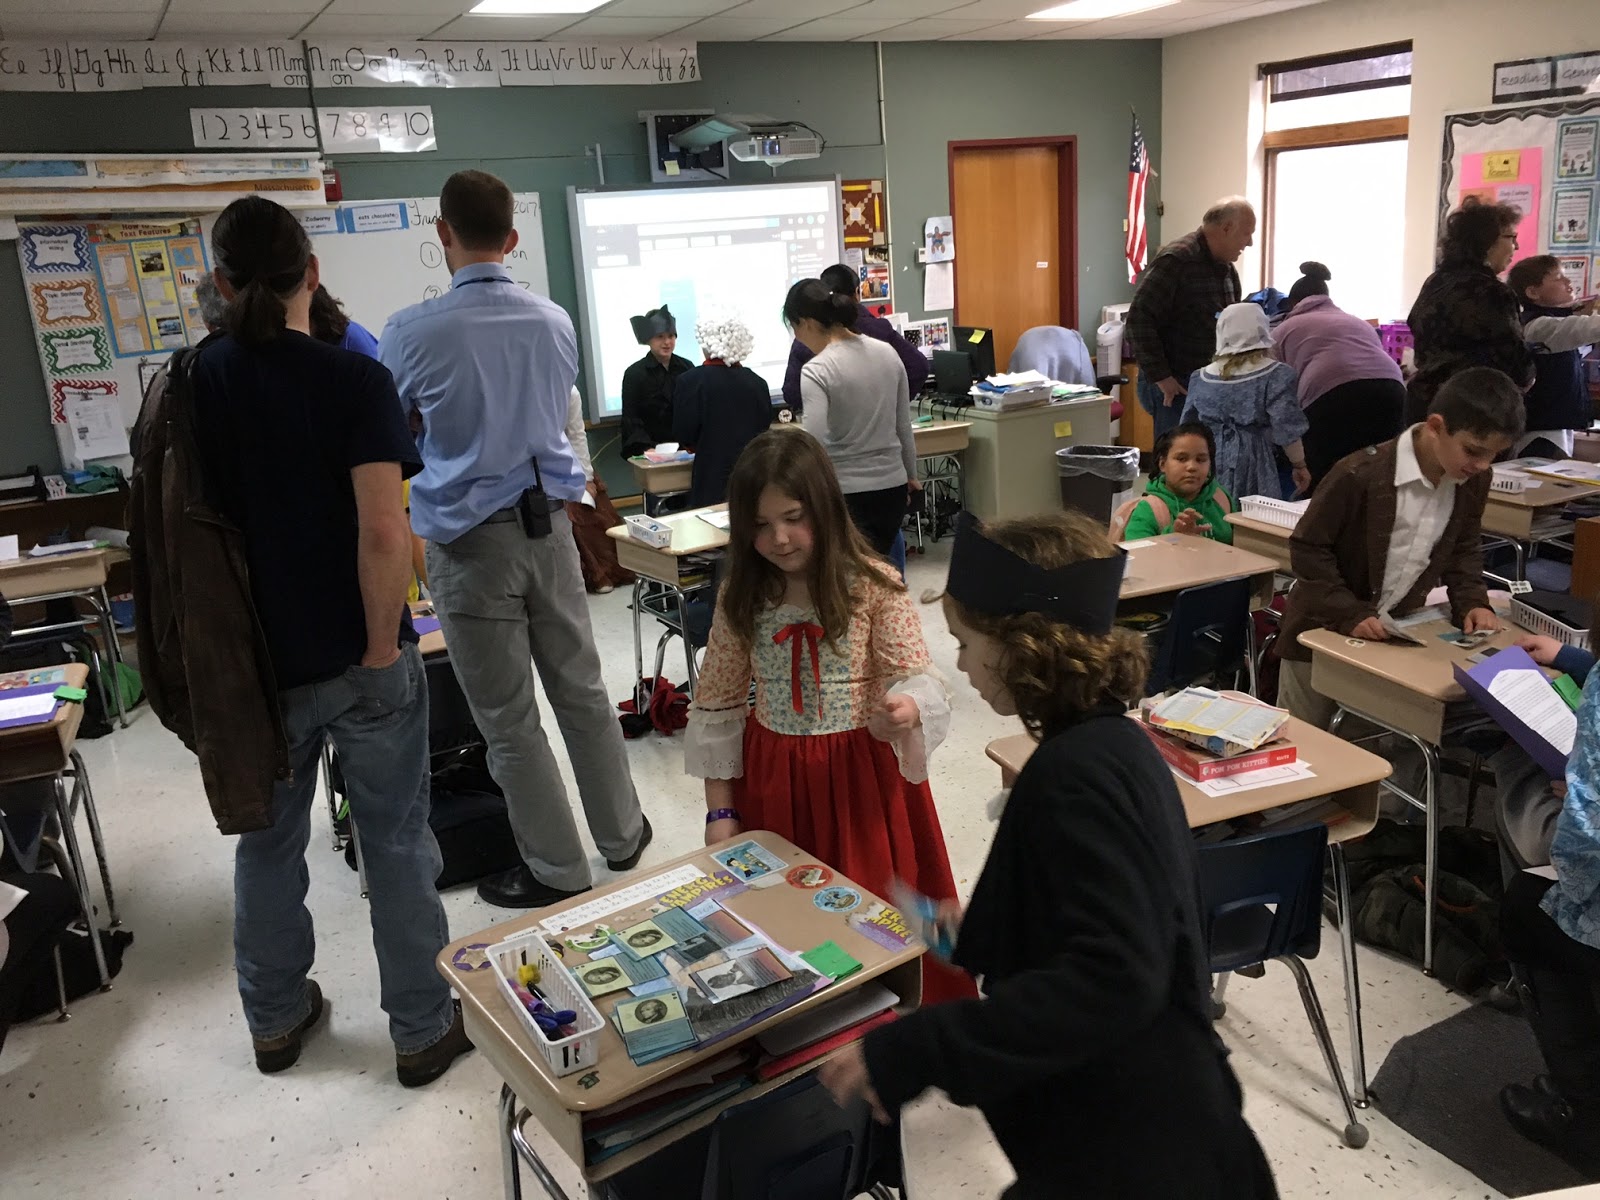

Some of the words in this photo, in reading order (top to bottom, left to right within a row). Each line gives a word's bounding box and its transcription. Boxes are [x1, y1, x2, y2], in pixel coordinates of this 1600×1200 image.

[1500, 73, 1550, 86] Reading
[200, 114, 207, 140] 1
[215, 115, 231, 140] 2
[239, 114, 251, 139] 3
[255, 114, 273, 139] 4
[278, 114, 294, 139] 5
[301, 114, 318, 139] 6
[326, 114, 340, 138] 7
[352, 113, 367, 137] 8
[404, 112, 430, 137] 10
[1242, 757, 1268, 769] KITTIES
